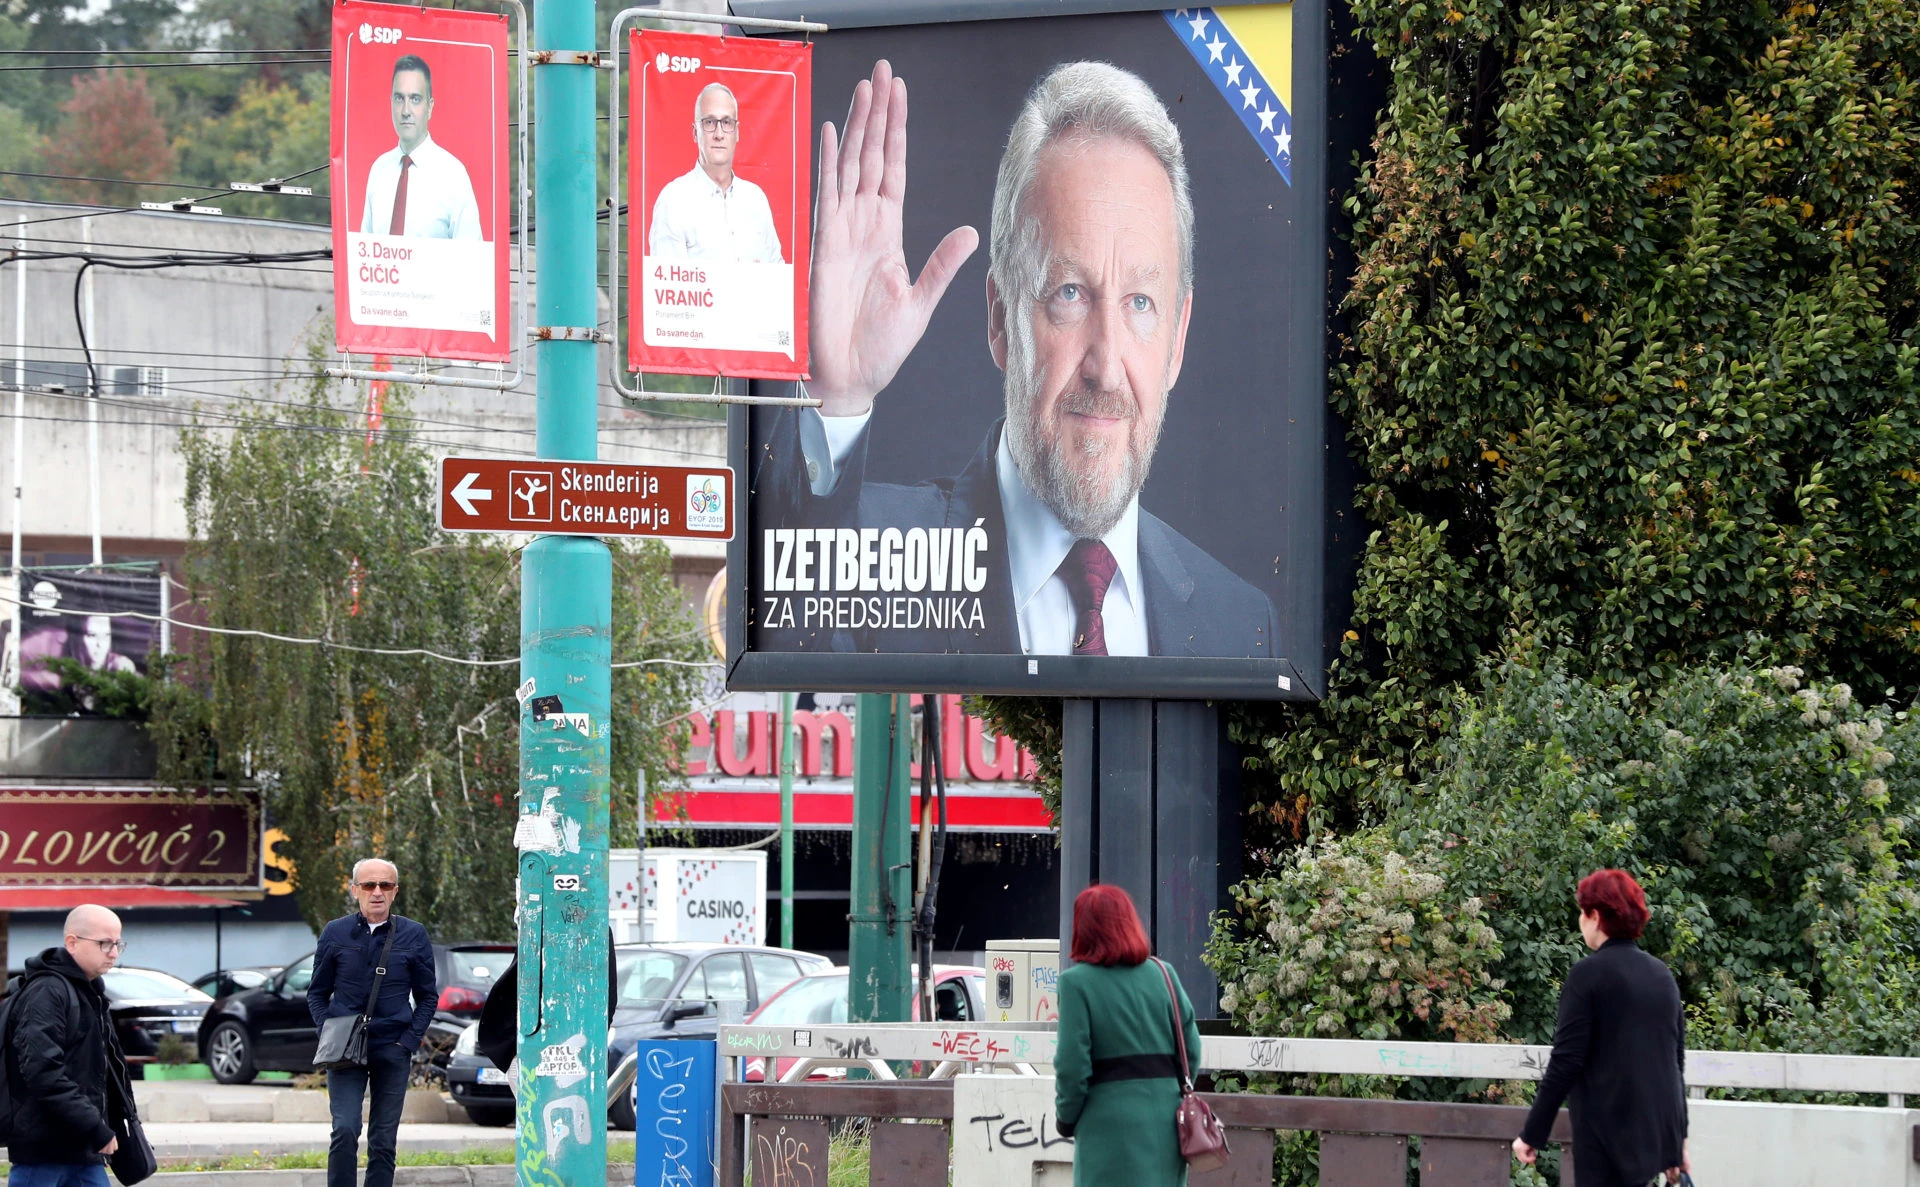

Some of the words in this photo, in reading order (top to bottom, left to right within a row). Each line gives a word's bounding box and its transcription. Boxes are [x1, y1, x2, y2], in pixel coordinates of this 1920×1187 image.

[374, 26, 403, 44] SDP
[671, 56, 701, 73] SDP
[358, 241, 370, 258] 3.
[373, 242, 413, 260] Davor
[359, 262, 400, 285] ČIČIĆ
[654, 265, 667, 281] 4.
[670, 265, 706, 283] Haris
[654, 288, 714, 307] VRANIĆ
[361, 306, 371, 315] Da
[372, 308, 392, 316] svane
[656, 328, 666, 337] Da
[667, 330, 689, 338] svane
[560, 467, 659, 499] Skenderija
[560, 499, 670, 530] Скендерија
[688, 515, 707, 523] EYOF
[763, 518, 988, 592] IZETBEGOVIĆ
[763, 597, 796, 628] ZA
[804, 597, 986, 629] PREDSJEDNIKA
[200, 830, 226, 866] 2
[687, 900, 744, 918] CASINO
